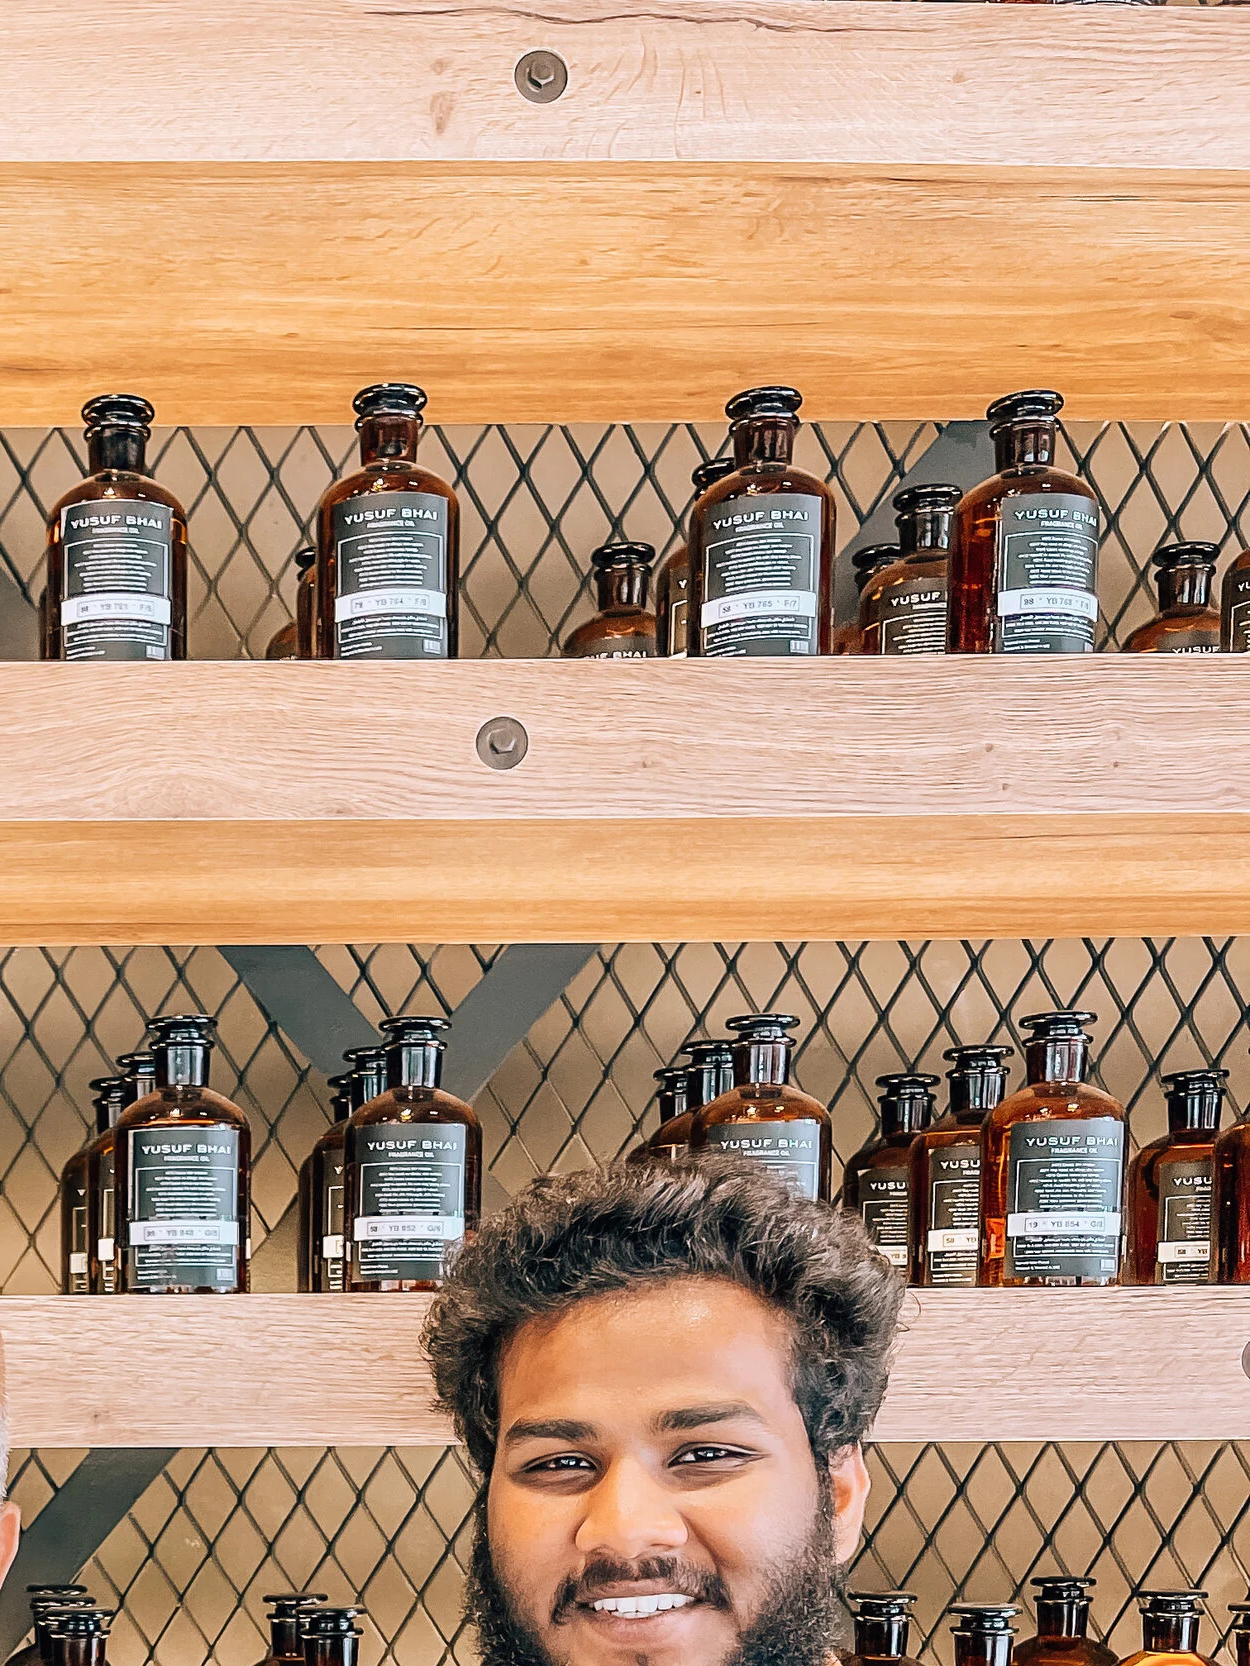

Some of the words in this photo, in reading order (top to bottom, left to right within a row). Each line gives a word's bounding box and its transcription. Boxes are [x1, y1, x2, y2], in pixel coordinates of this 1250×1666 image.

[70, 515, 121, 530] YUSUF
[126, 515, 162, 530] BHAI
[344, 508, 396, 526] YUSUF
[402, 508, 438, 521] BHAI
[712, 511, 765, 530] YUSUF
[770, 510, 809, 522] BHAI
[1014, 509, 1069, 520] YUSUF
[1073, 510, 1097, 526] BHAI
[891, 592, 941, 606] YUSUF
[367, 1140, 417, 1150] YUSUF
[422, 1140, 457, 1150] BHAI
[720, 1139, 772, 1150] YUSUF
[778, 1138, 812, 1149] BHAI
[1026, 1137, 1080, 1147] YUSUF
[1086, 1136, 1118, 1146] BHAI
[141, 1144, 193, 1155] YUSUF
[196, 1145, 232, 1154] BHAI
[940, 1160, 980, 1171] YUSU
[870, 1182, 906, 1190] YUSU
[1172, 1176, 1213, 1186] YUSU
